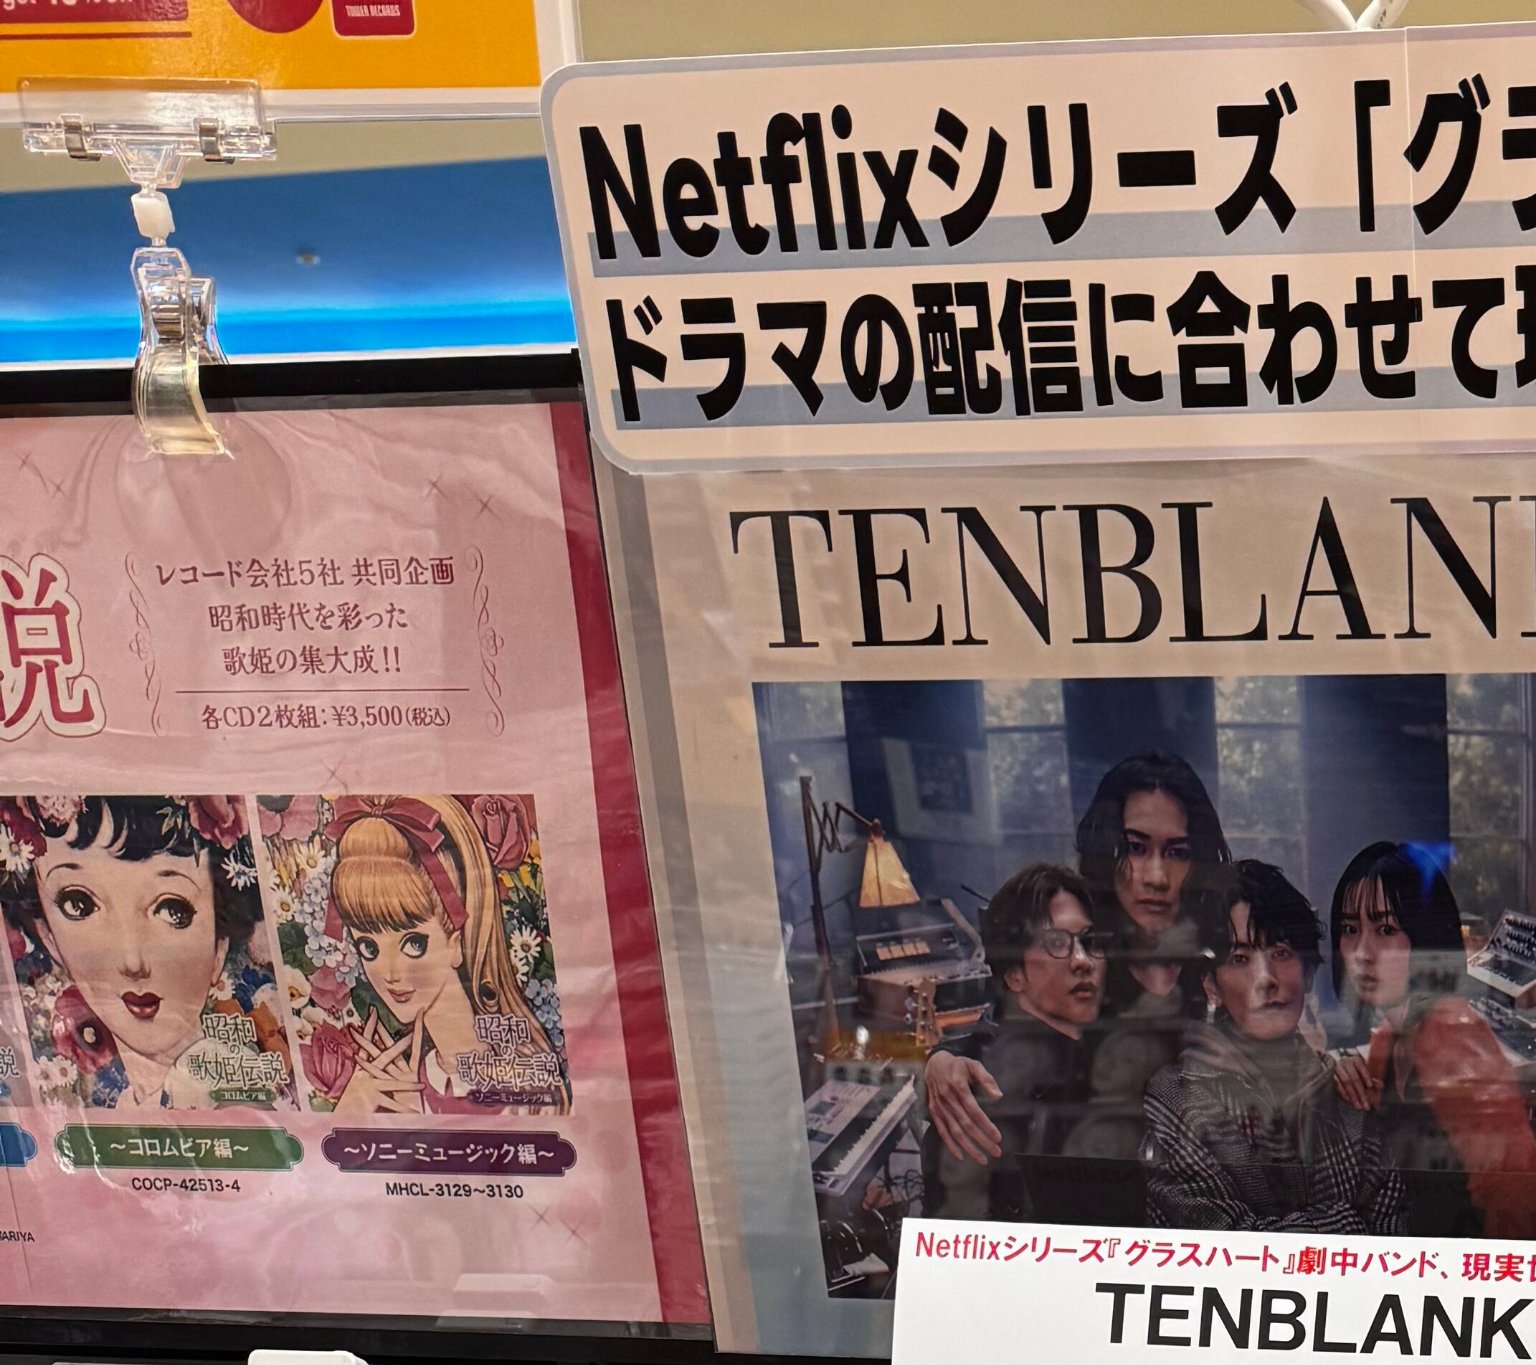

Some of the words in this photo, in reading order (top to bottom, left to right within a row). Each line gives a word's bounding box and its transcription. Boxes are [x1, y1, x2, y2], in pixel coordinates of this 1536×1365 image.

[156, 559, 344, 587] レコード会社5社
[353, 557, 454, 586] 共同企画
[208, 602, 408, 630] 昭和時代を彩った
[223, 645, 401, 674] 歌姫の集大成!!
[132, 1177, 240, 1194] COCP-42513-4
[1096, 1282, 1534, 1361] TENBLANK
